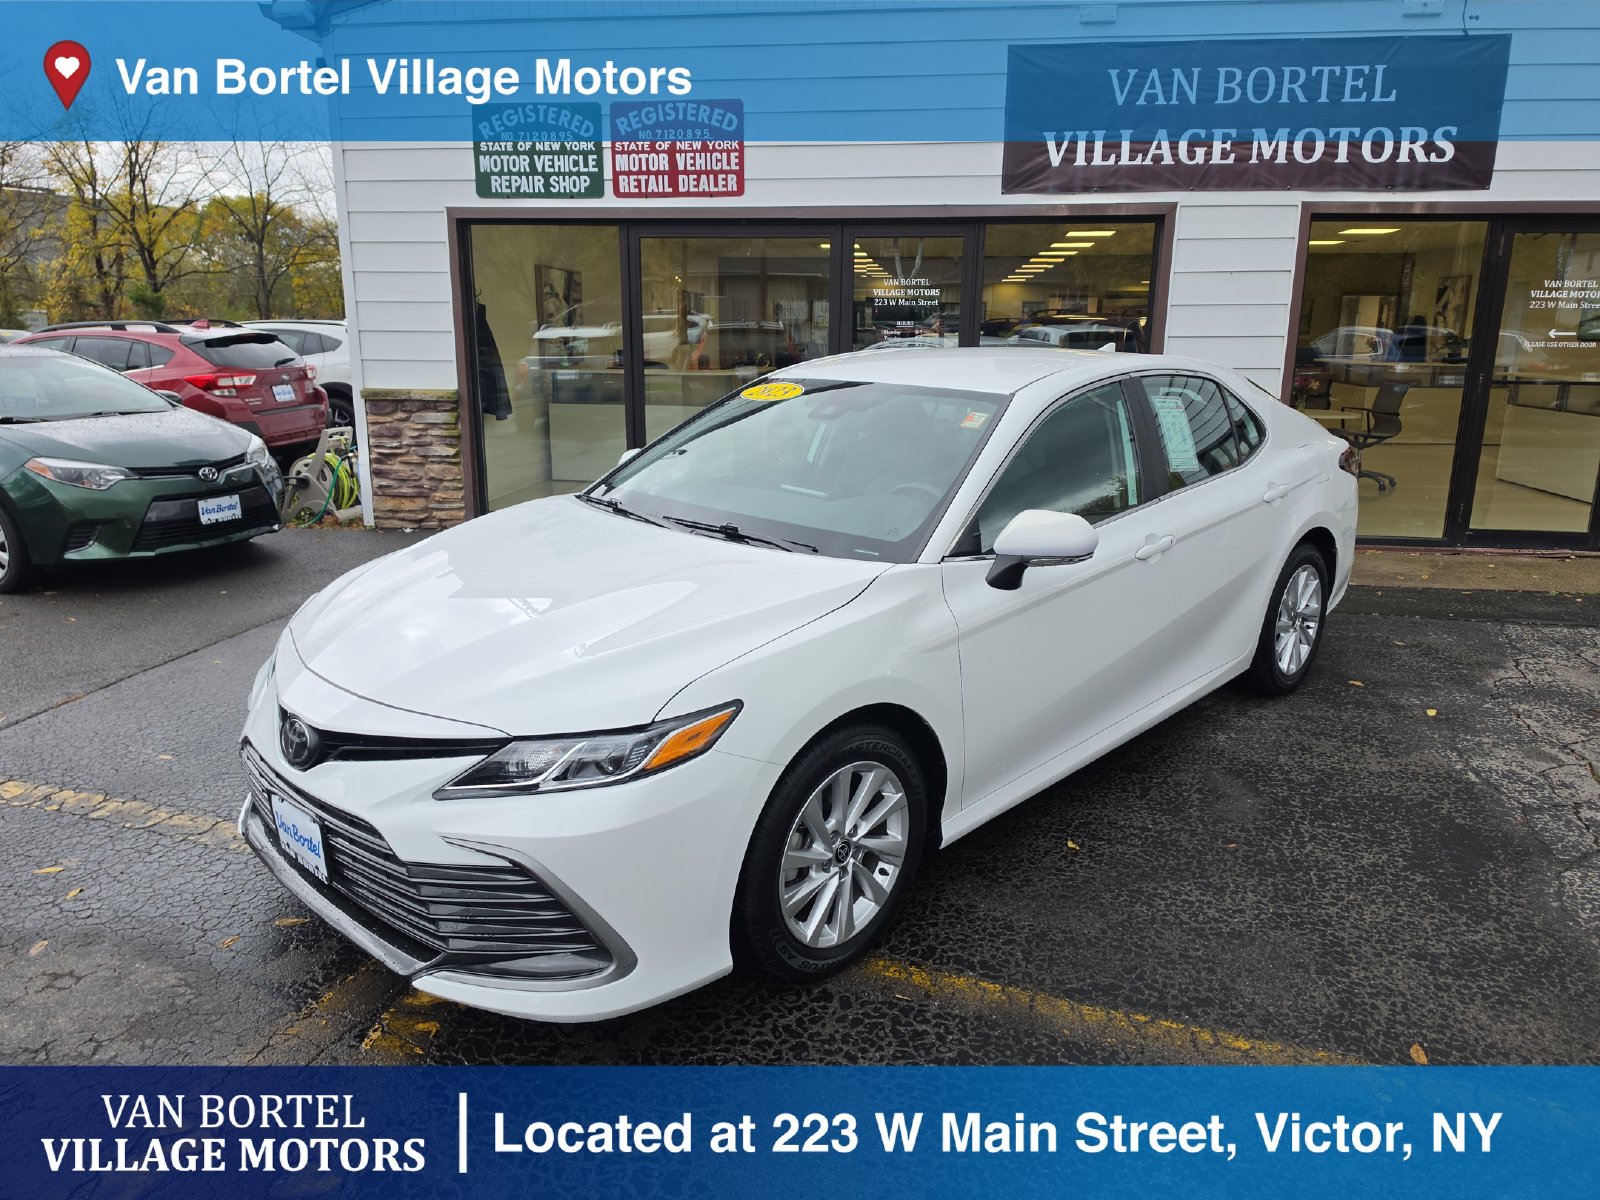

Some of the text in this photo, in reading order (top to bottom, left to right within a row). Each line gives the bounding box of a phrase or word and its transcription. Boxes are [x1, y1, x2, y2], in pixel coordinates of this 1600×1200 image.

[1108, 64, 1397, 106] VAN BORTEL
[478, 103, 595, 140] REGISTERED
[616, 102, 738, 136] REGISTERED
[517, 131, 574, 142] 7120895
[655, 128, 711, 140] 7120895
[480, 141, 596, 151] STATE OF NEW YORK
[615, 140, 739, 151] STATE OF NEW YORK
[1043, 125, 1458, 166] VILLAGE MOTORS
[479, 154, 598, 173] MOTOR VEHICLE
[615, 152, 740, 172] MOTOR VEHICLE
[491, 175, 590, 193] REPAIR SHOP
[619, 173, 738, 193] RETAIL DEALER
[883, 278, 931, 286] VAN BORTEL
[1544, 279, 1599, 288] VAN BORTEL
[873, 288, 941, 296] VILLAGE MOTORS
[1530, 290, 1600, 298] VILLAGE MOTO
[874, 298, 939, 306] 223 W Main Street
[1529, 301, 1546, 309] 223
[1558, 301, 1578, 309] Main
[1580, 301, 1600, 309] Stree
